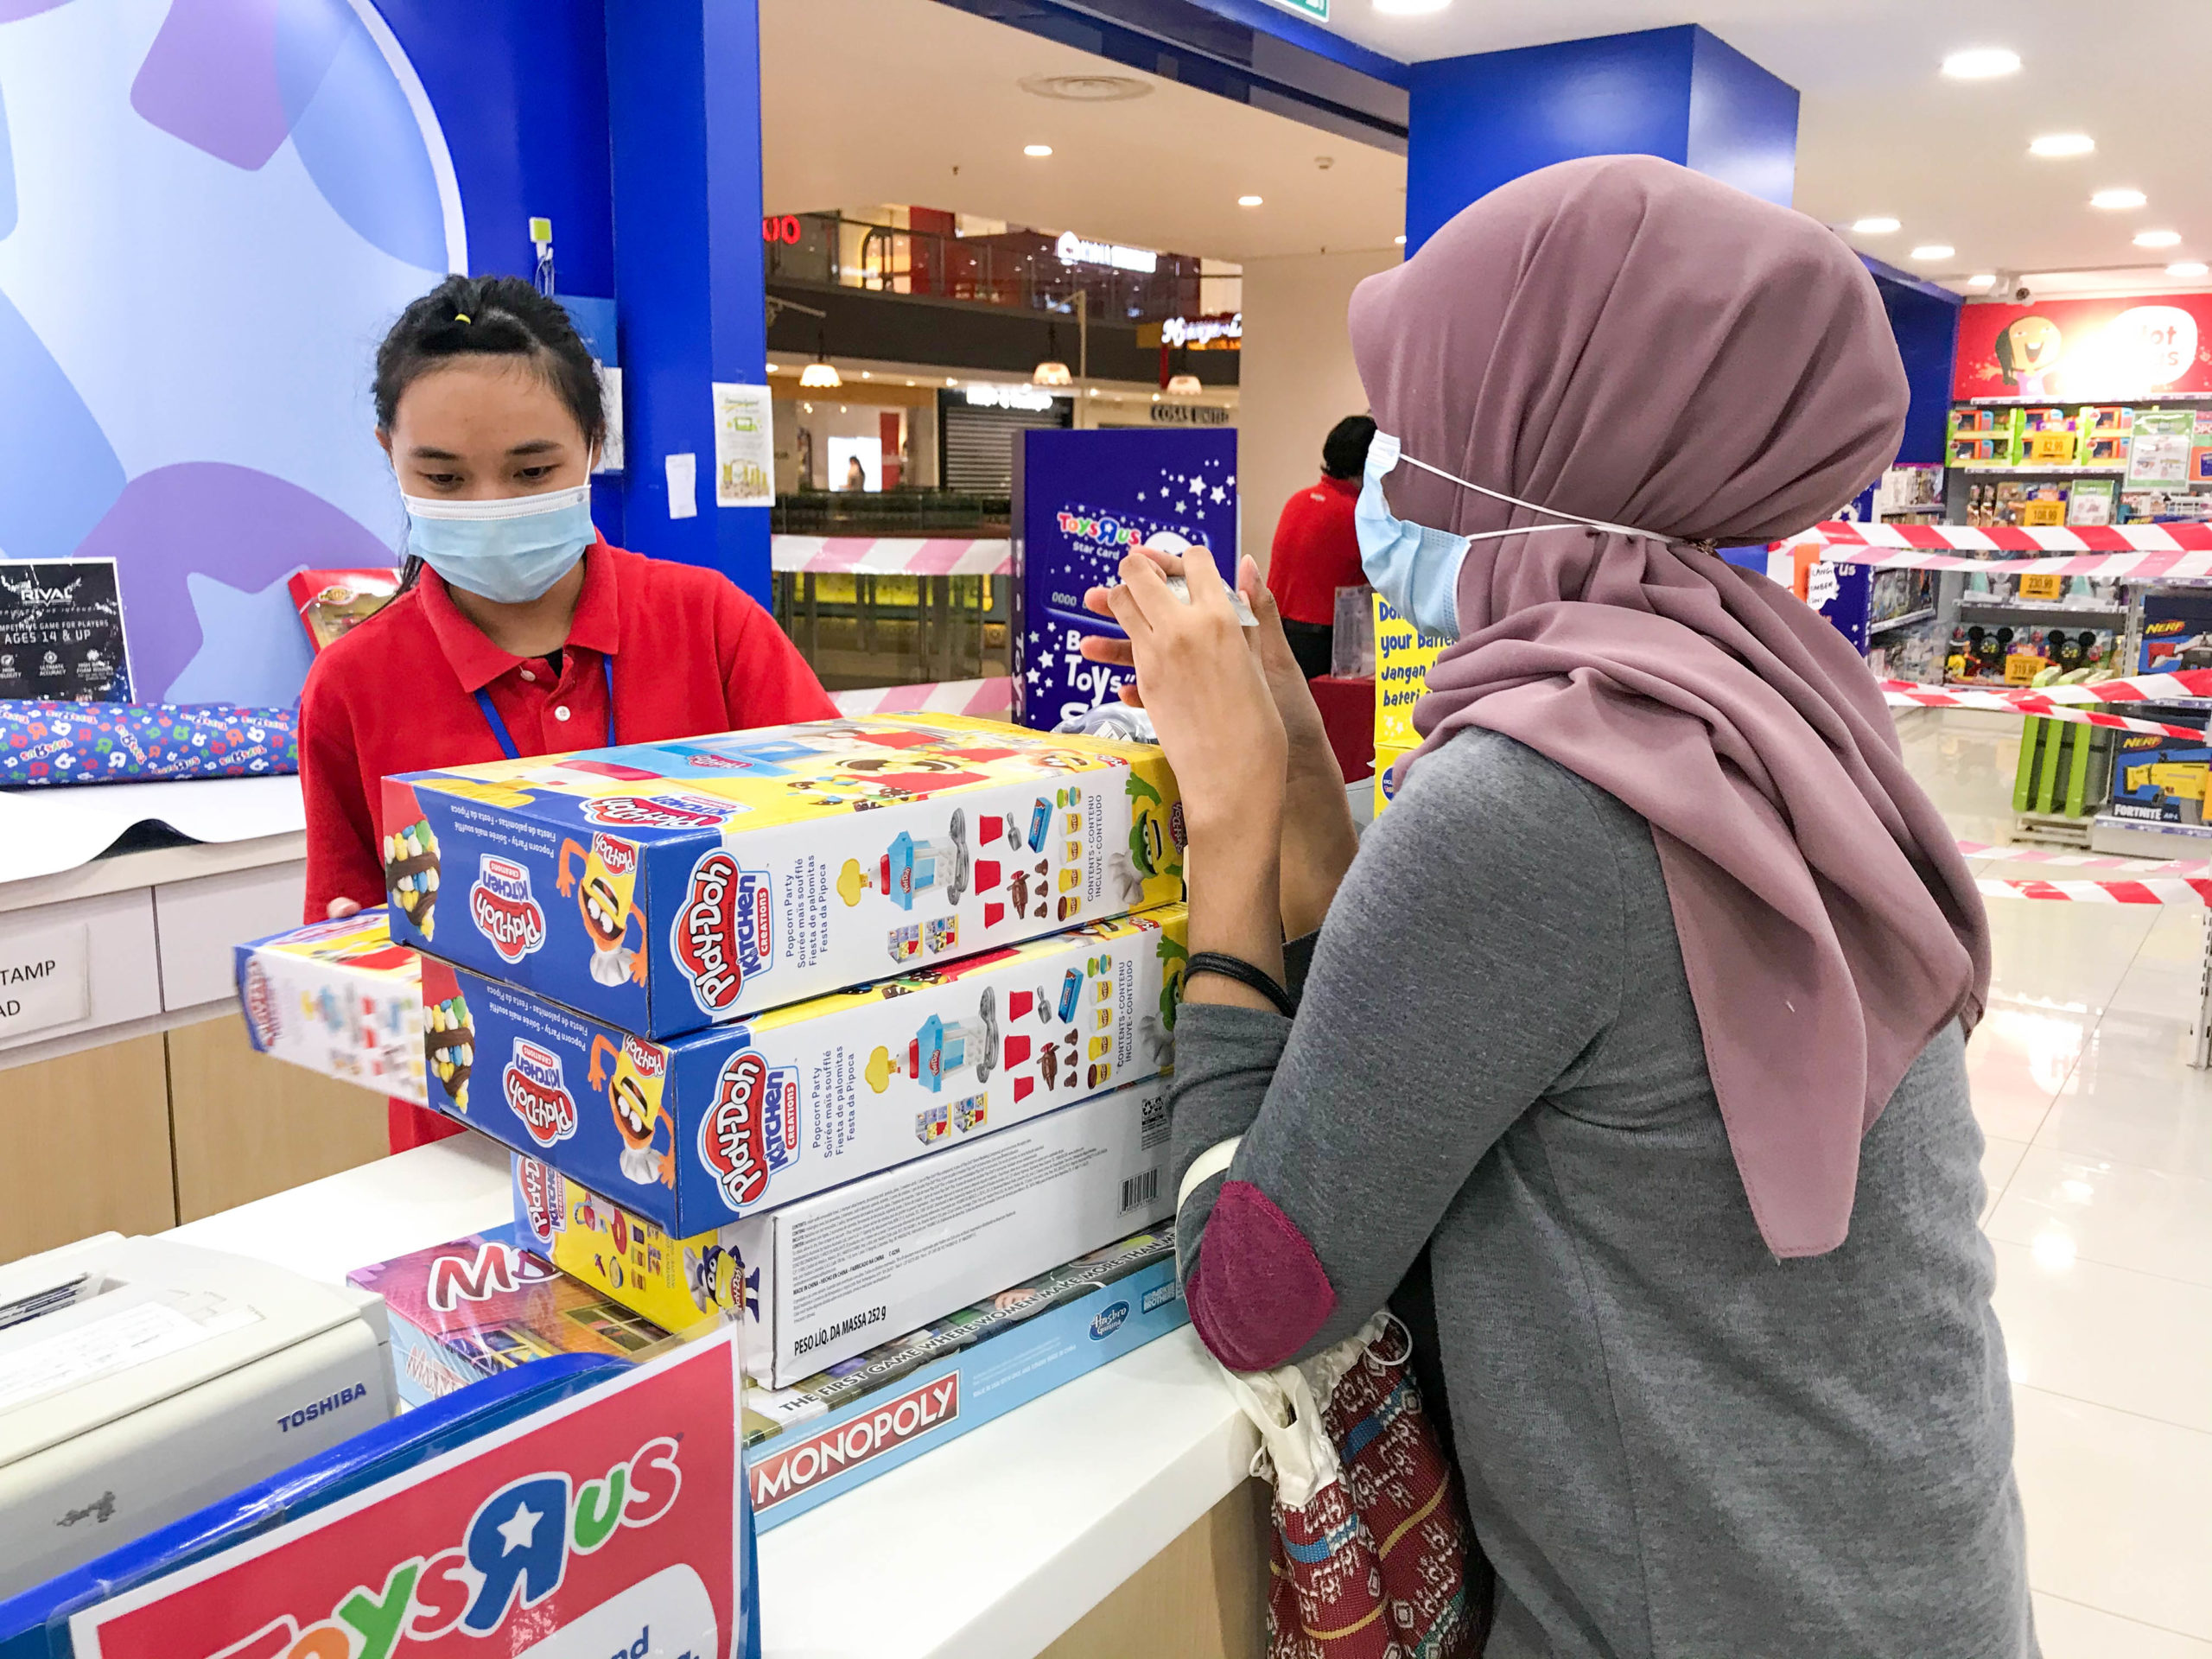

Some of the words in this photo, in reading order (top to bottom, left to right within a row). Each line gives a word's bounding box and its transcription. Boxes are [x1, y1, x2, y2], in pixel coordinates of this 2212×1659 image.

[1072, 542, 1094, 556] Star
[1096, 546, 1120, 560] Card
[4, 632, 36, 645] AGES
[43, 631, 57, 643] 14
[75, 629, 92, 641] UP
[1381, 633, 1412, 658] your
[1381, 664, 1426, 684] Jangan
[1383, 689, 1421, 707] bateri
[2113, 804, 2162, 820] FORTNITE
[785, 874, 794, 906] Party
[807, 855, 817, 912] palomitas
[818, 863, 829, 902] Pipoca
[808, 914, 816, 928] de
[818, 905, 827, 918] da
[690, 861, 735, 1007] Play-Doh
[785, 909, 795, 957] Popcorn
[796, 931, 805, 969] Soirée
[808, 931, 817, 966] Fiesta
[819, 921, 828, 952] Festa
[0, 958, 57, 988] TAMP
[1116, 1014, 1125, 1068] CONTENTS
[812, 1067, 823, 1098] Party
[836, 1046, 844, 1102] palomitas
[847, 1052, 855, 1091] Pipoca
[836, 1104, 843, 1118] de
[847, 1094, 855, 1108] da
[716, 1061, 762, 1204] Play-Doh
[812, 1101, 822, 1148] Popcorn
[824, 1122, 833, 1159] Soirée
[836, 1121, 844, 1156] Fiesta
[525, 1158, 548, 1232] Play-D
[779, 1392, 819, 1413] THE
[818, 1370, 868, 1400] FIRST
[868, 1348, 920, 1376] GAME
[919, 1322, 976, 1352] WHERE
[976, 1294, 1037, 1326] WOMEN
[1040, 1274, 1081, 1300] MAKE
[1083, 1256, 1126, 1281] MORE
[1123, 1241, 1162, 1261] THAN
[794, 1331, 814, 1357] PESO
[814, 1325, 830, 1351] LÍQ.
[830, 1323, 841, 1340] DA
[841, 1314, 867, 1338] MASSA
[868, 1307, 880, 1327] 252
[880, 1305, 887, 1322] g
[1090, 1307, 1127, 1328] Hasbro
[277, 1382, 367, 1433] TOSHIBA
[757, 1381, 956, 1503] MONOPOLY
